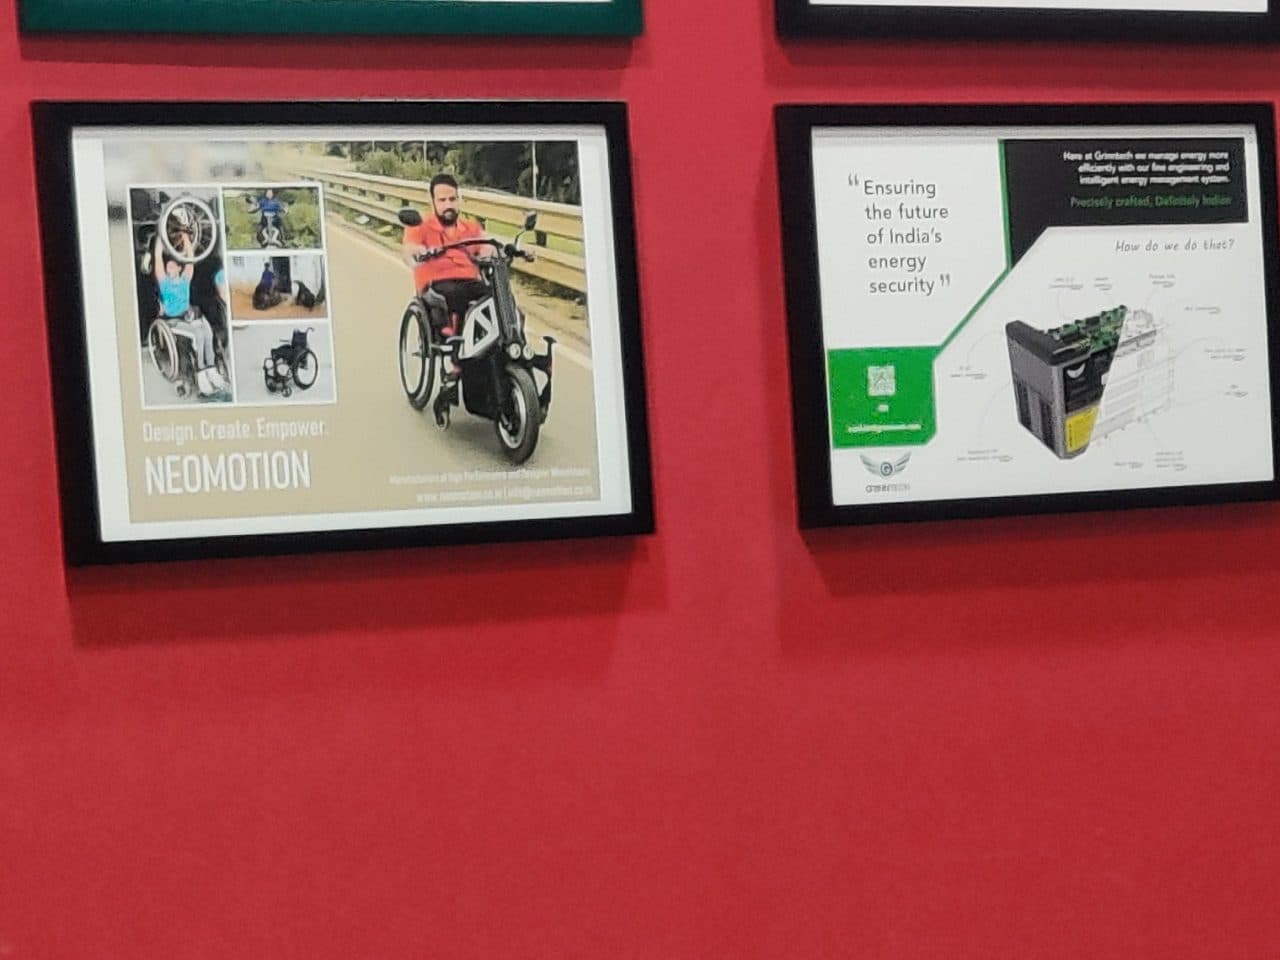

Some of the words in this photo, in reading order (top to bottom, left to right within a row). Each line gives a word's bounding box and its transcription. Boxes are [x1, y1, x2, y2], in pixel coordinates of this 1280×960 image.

[1180, 152, 1207, 162] energy
[1118, 162, 1136, 172] with
[863, 178, 936, 199] Ensuring
[1120, 175, 1148, 187] energy
[864, 202, 892, 220] the
[898, 202, 949, 220] future
[866, 227, 885, 244] of
[889, 226, 943, 244] India's
[1115, 239, 1141, 252] How
[1145, 239, 1159, 251] do
[1164, 242, 1180, 251] we
[1184, 238, 1198, 251] do
[1203, 238, 1236, 251] that?
[868, 256, 927, 273] energy
[869, 276, 936, 297] security
[144, 449, 313, 496] NEOMOTION
